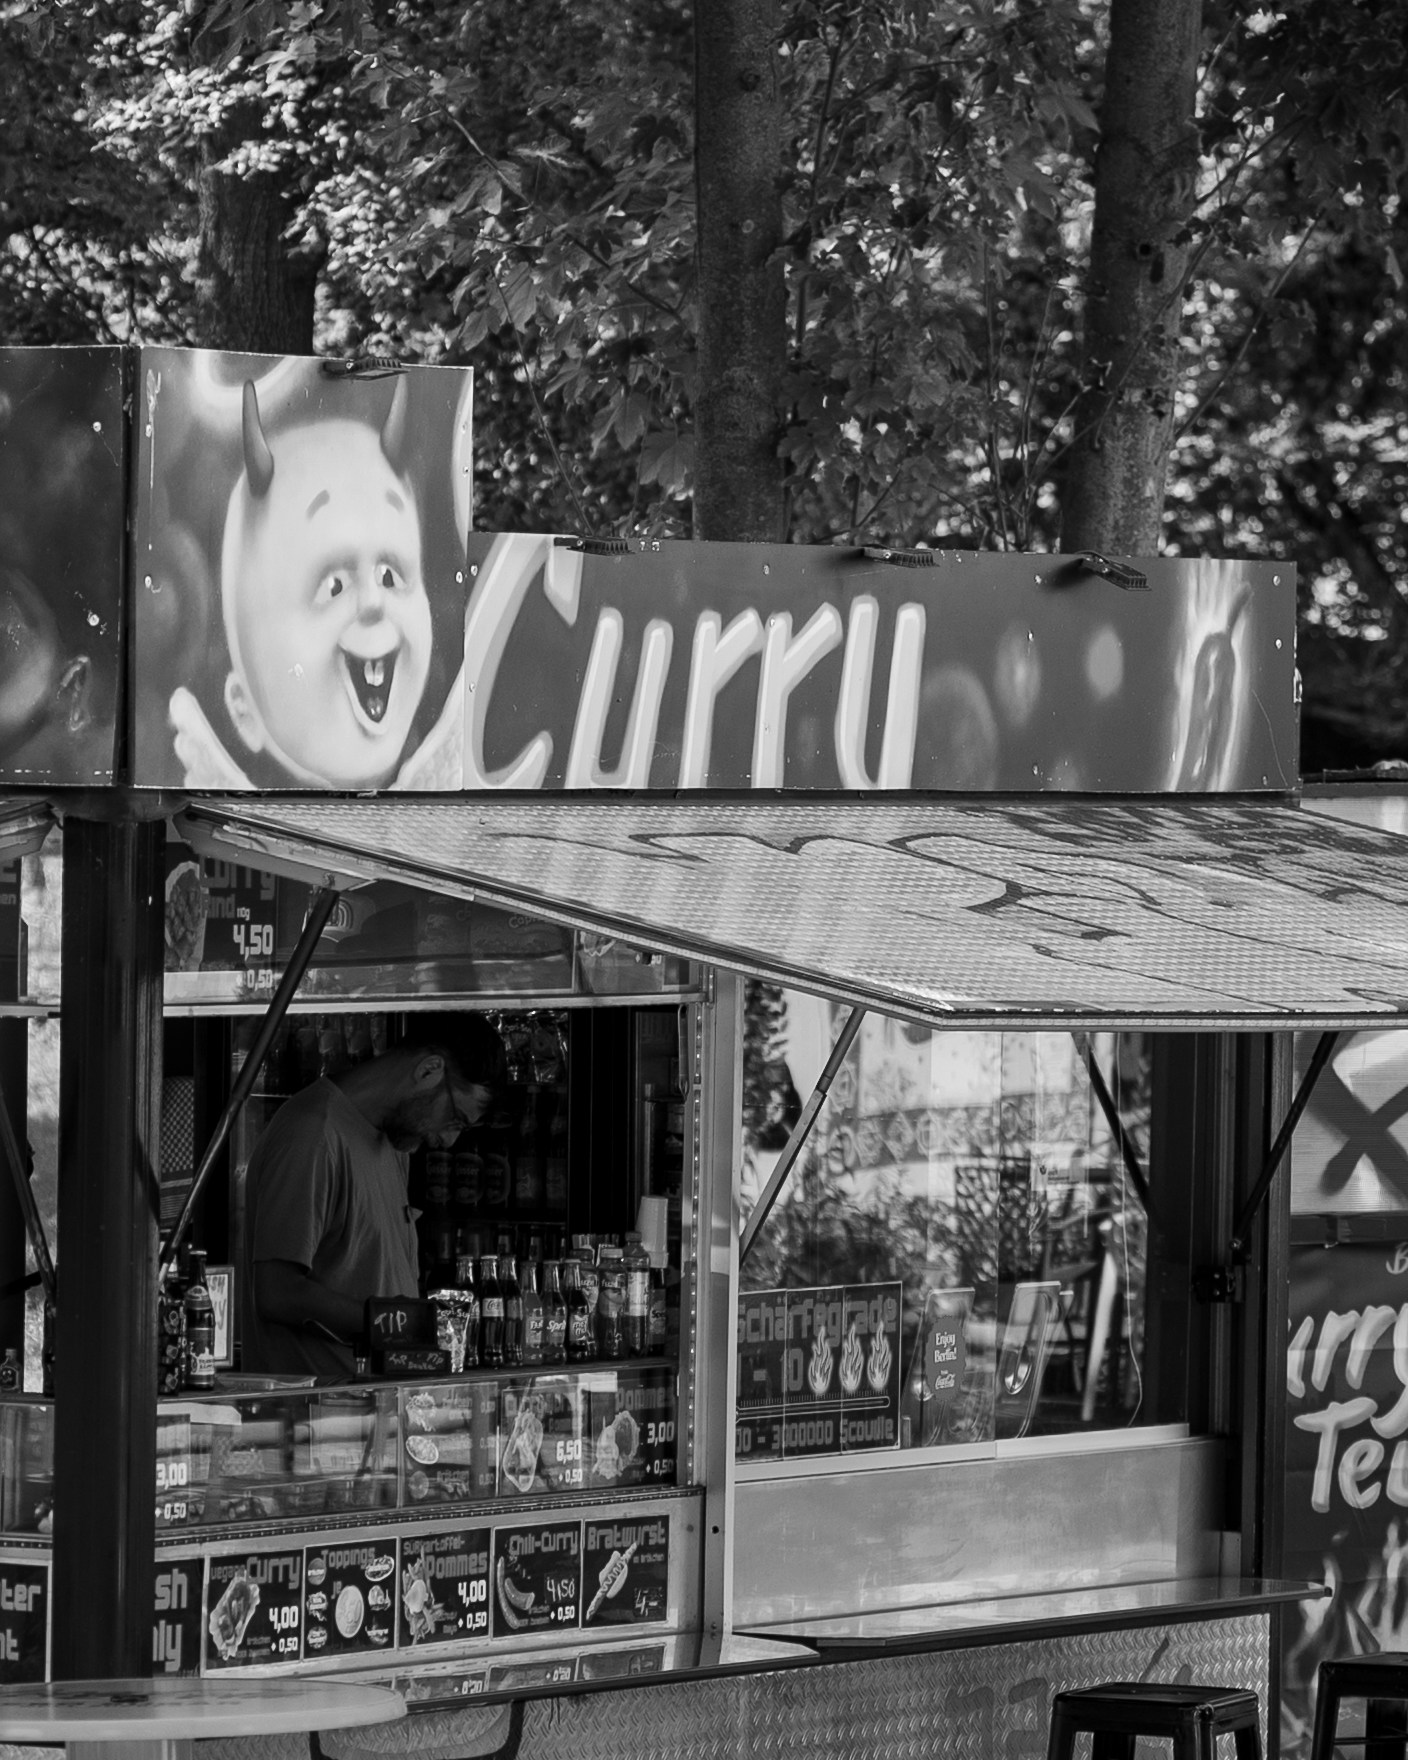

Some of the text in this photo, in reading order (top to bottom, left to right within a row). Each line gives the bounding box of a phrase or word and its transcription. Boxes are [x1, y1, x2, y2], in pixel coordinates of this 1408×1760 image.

[233, 925, 274, 961] 4,50
[374, 1310, 408, 1334] TIP
[647, 1421, 675, 1447] 3,00
[556, 1439, 582, 1464] 6,50
[156, 1463, 187, 1490] 3,00
[565, 1469, 583, 1484] 0,50
[653, 1459, 674, 1477] 0,50
[164, 1502, 187, 1521] 0,50
[508, 1530, 578, 1556] Chili-Curry
[587, 1521, 666, 1550] Bratwurst
[320, 1547, 376, 1570] Toppings
[426, 1551, 488, 1580] Pommes
[246, 1556, 301, 1590] Curry
[458, 1579, 487, 1608] 4,00
[269, 1605, 299, 1634] 4,00
[467, 1611, 487, 1631] 0,50
[557, 1605, 575, 1622] 0,50
[279, 1636, 298, 1654] 0,50
